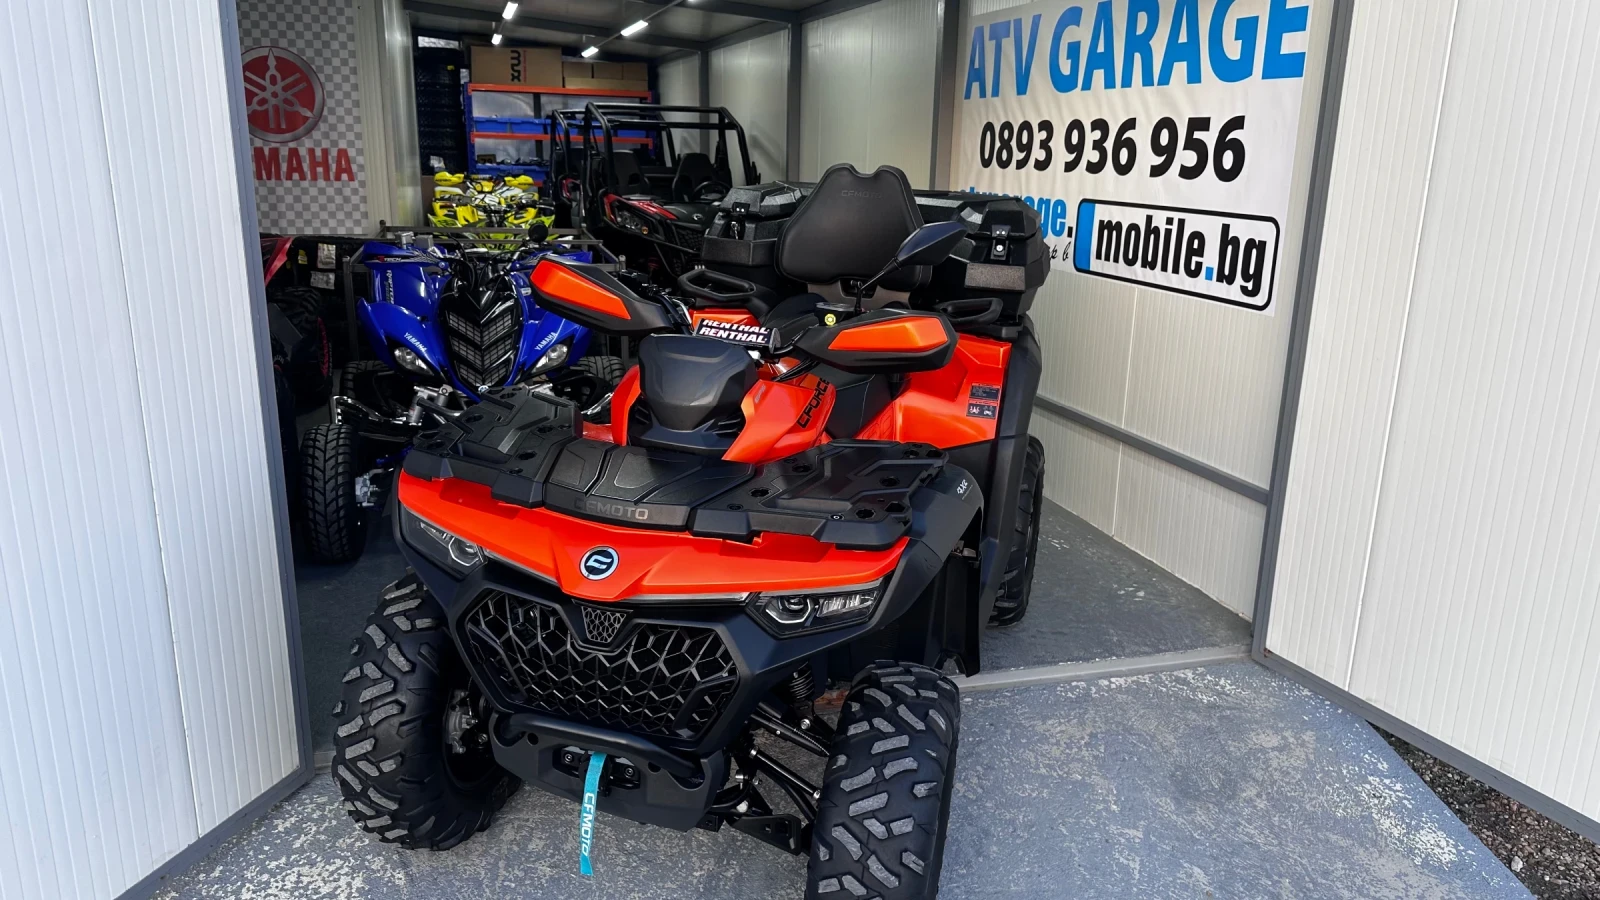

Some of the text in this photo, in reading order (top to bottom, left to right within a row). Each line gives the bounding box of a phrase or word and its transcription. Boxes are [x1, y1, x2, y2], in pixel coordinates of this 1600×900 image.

[964, 0, 1309, 100] ATV GARAGE
[254, 146, 355, 181] MAHA
[980, 115, 1245, 183] 0893 936 956
[1095, 214, 1267, 298] mobile.bg
[404, 332, 428, 351] YAMAHA
[534, 331, 557, 351] YAMAHA
[699, 326, 768, 344] RENTHAL
[702, 319, 769, 334] RENTHAL
[797, 377, 830, 429] CFORCE
[573, 496, 649, 520] CFMOTO
[581, 792, 595, 857] CFMOTO
